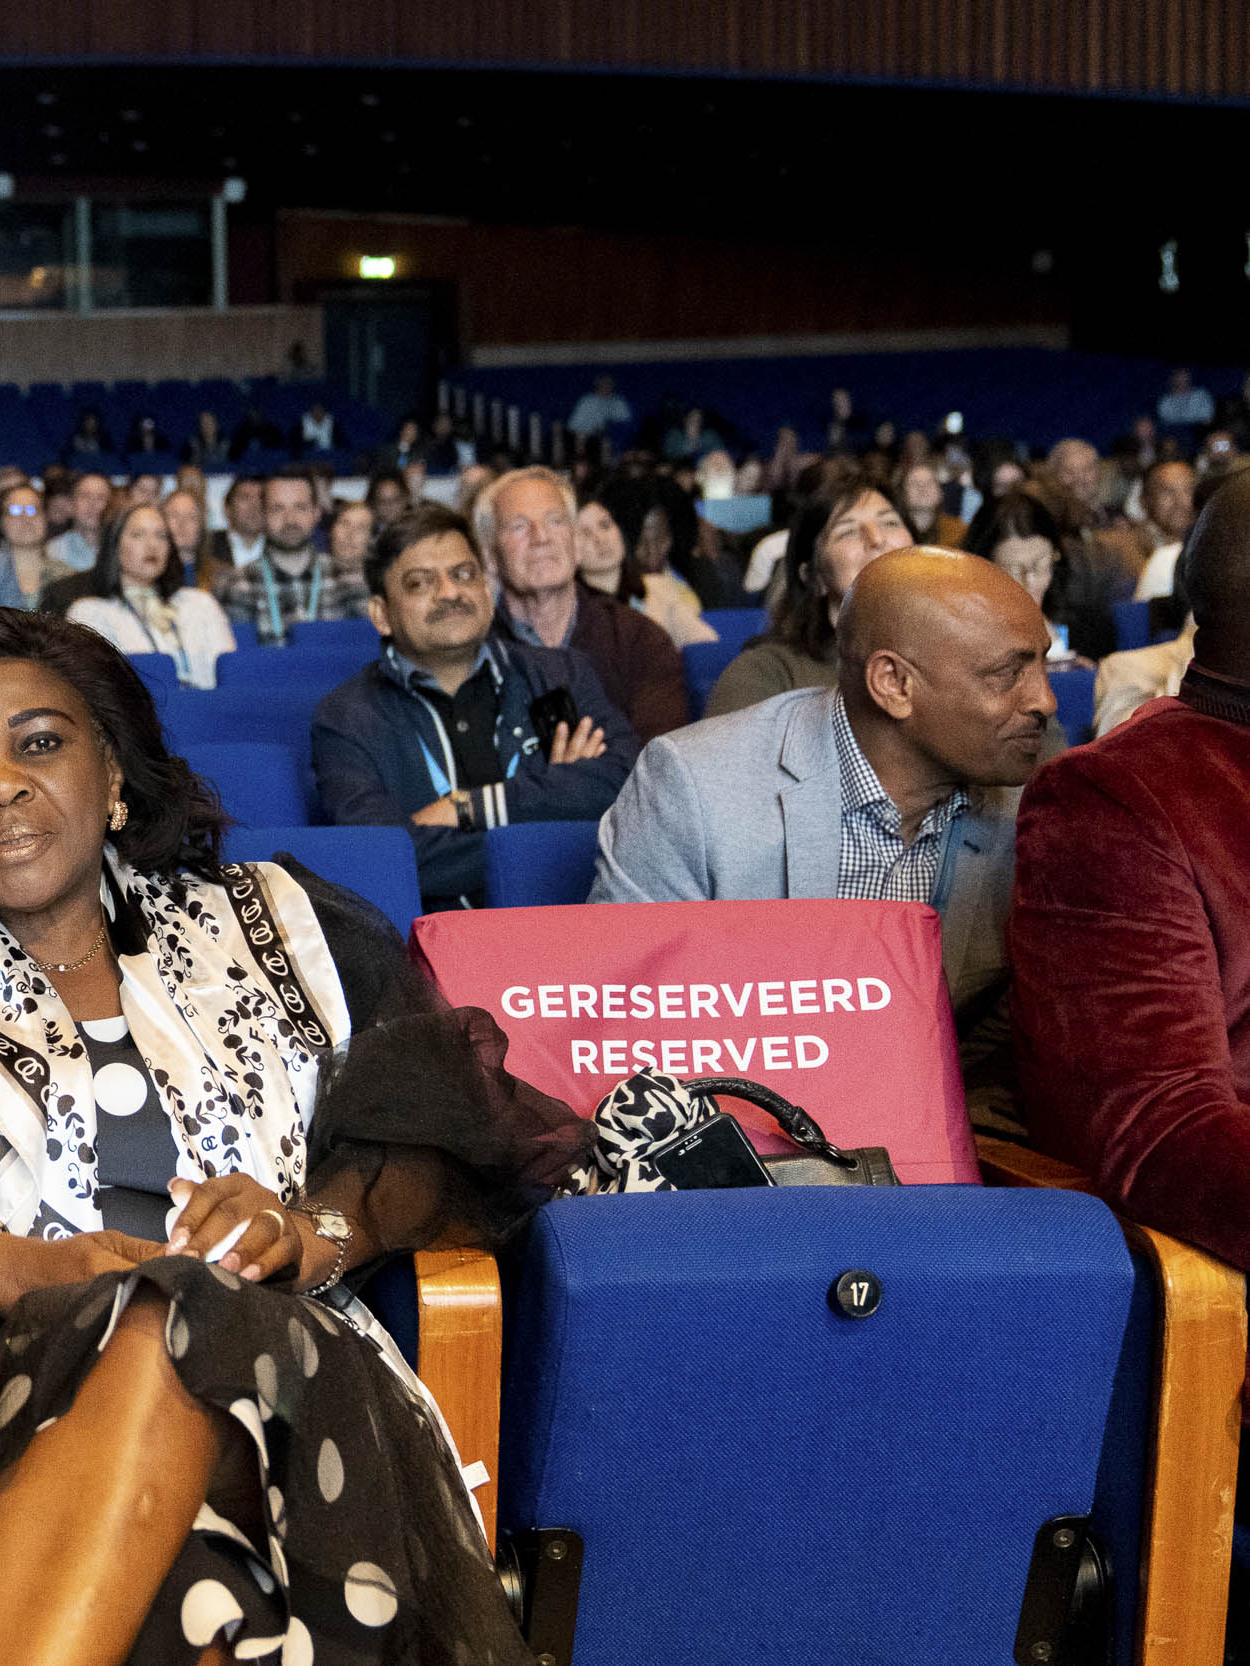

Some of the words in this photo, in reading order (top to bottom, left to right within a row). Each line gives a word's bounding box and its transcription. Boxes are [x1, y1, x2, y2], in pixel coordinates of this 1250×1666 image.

[500, 977, 892, 1019] GERESERVEERD
[570, 1035, 829, 1075] RESERVED
[849, 1281, 870, 1307] 17
